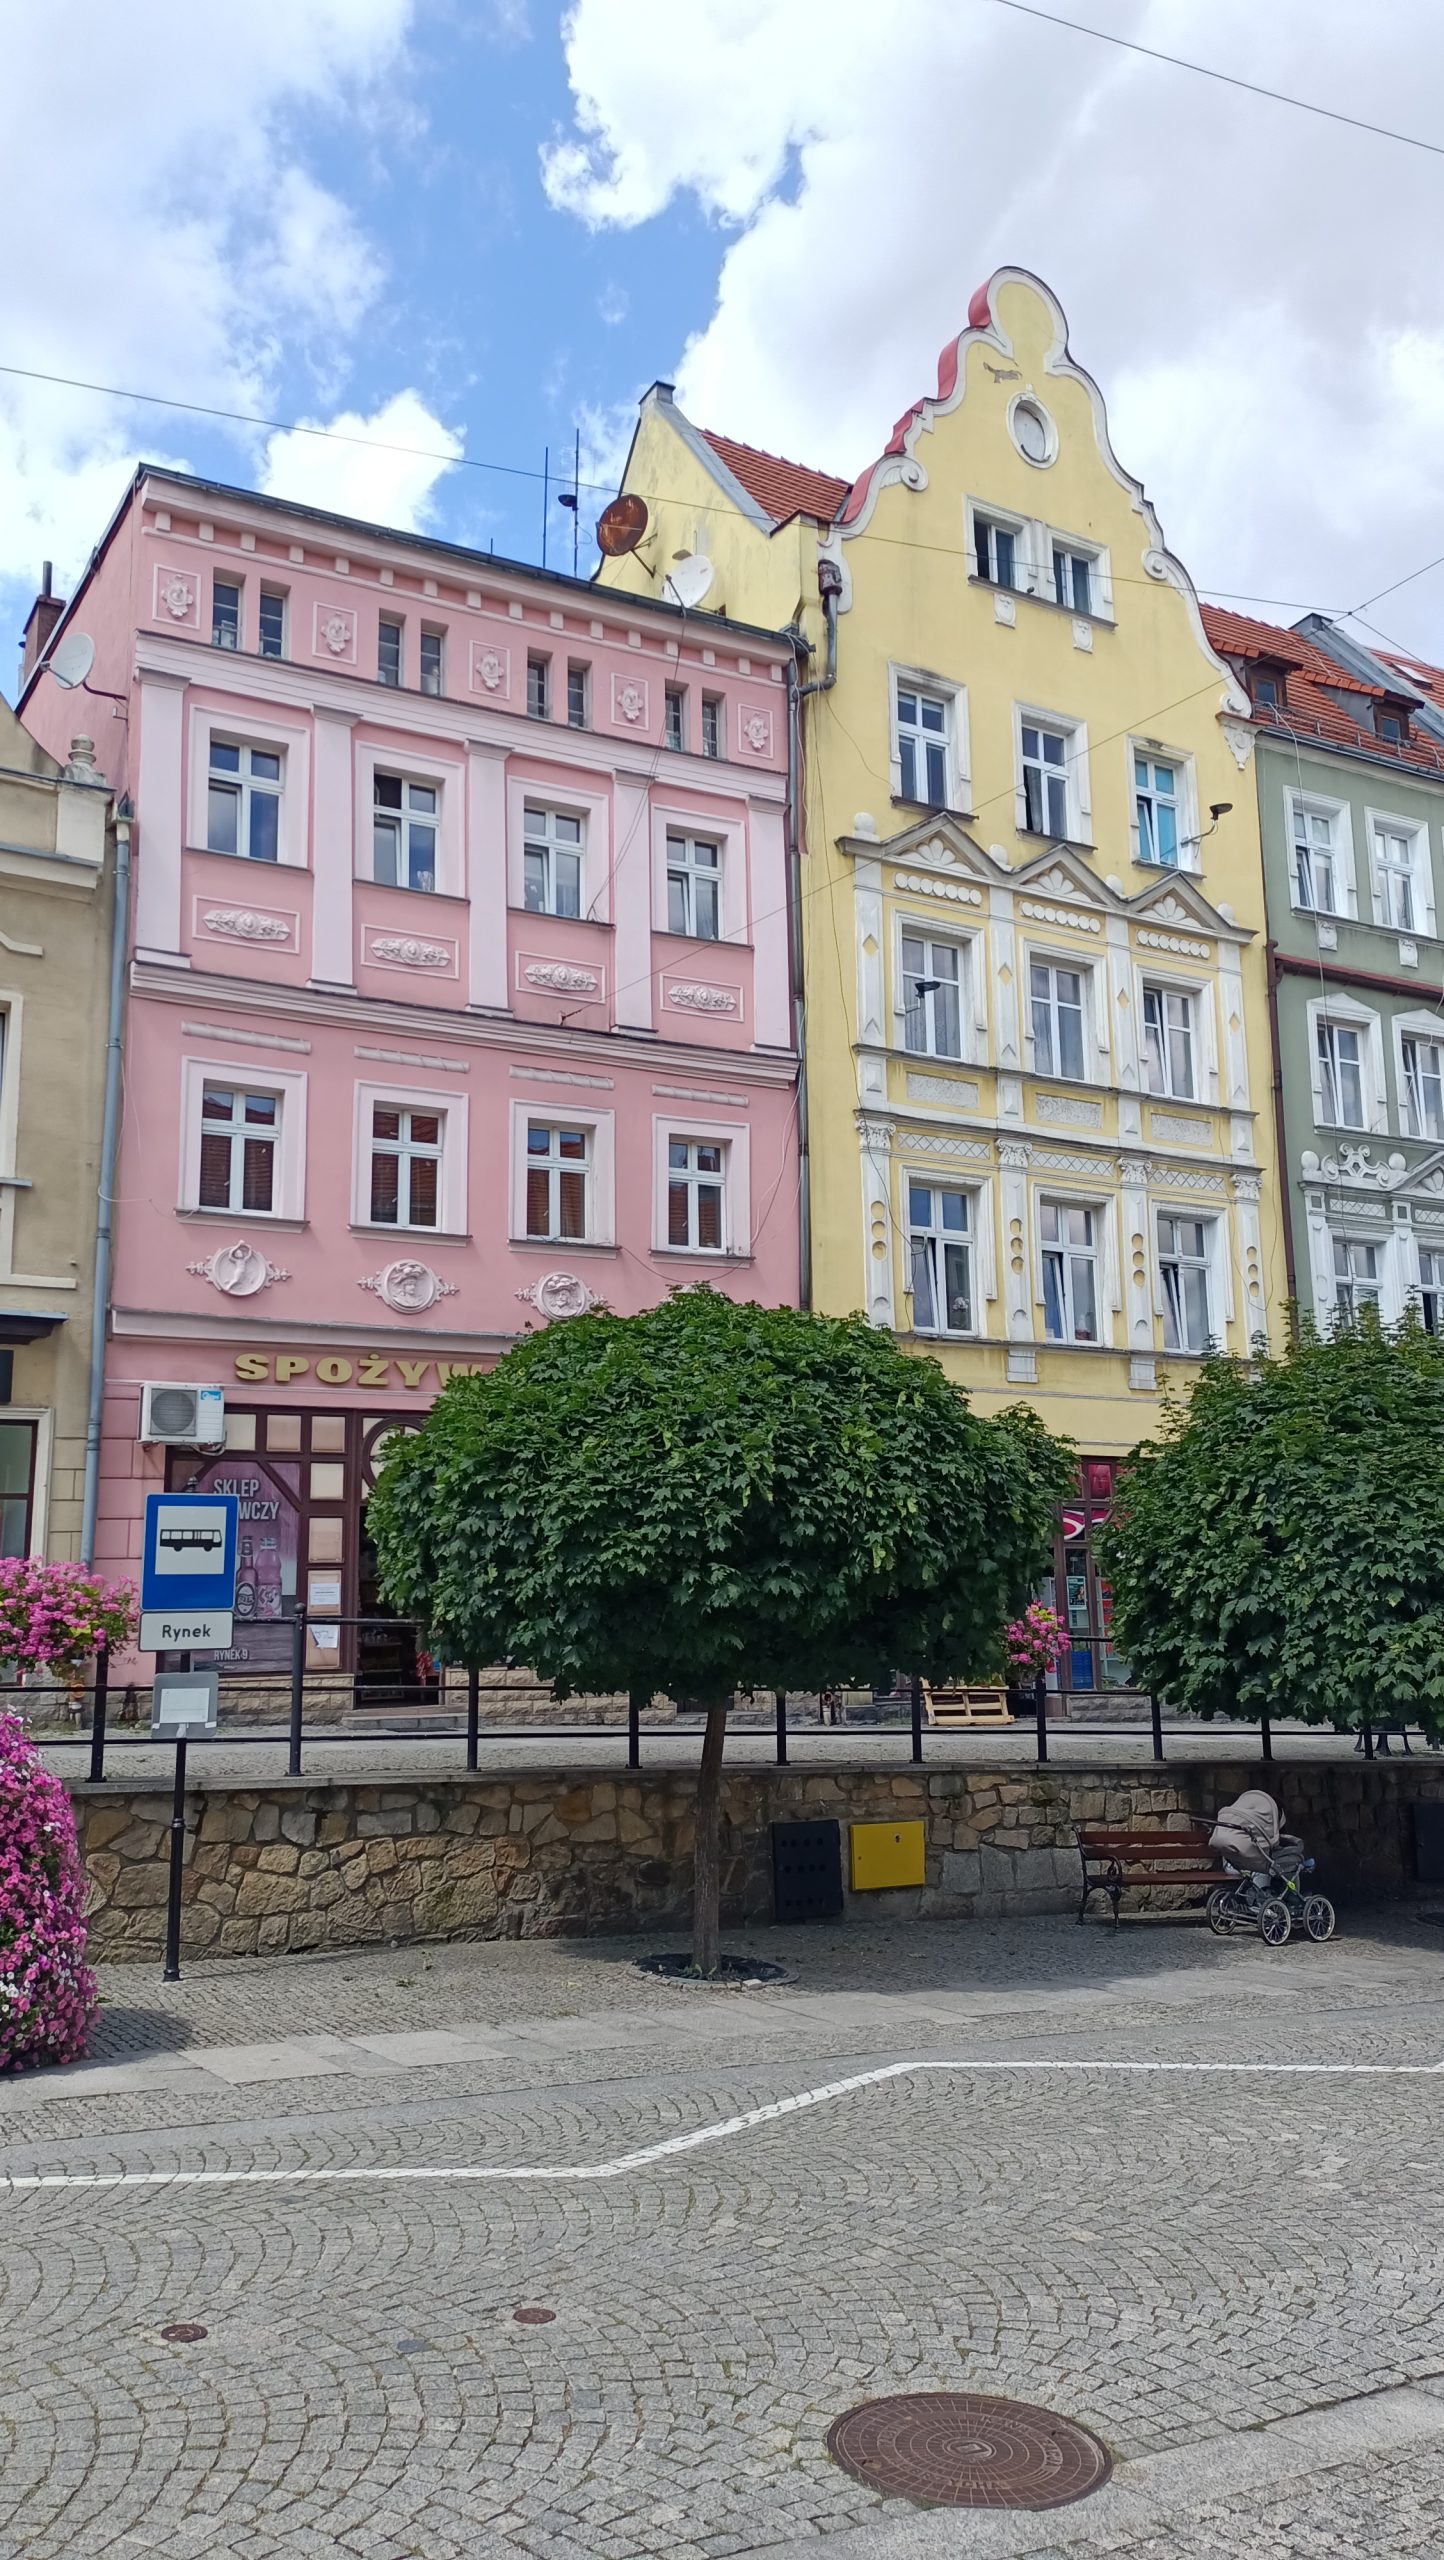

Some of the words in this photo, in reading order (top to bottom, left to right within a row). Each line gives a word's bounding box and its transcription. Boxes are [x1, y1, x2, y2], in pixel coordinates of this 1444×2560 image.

[234, 1353, 494, 1388] SPOŻYW
[213, 1479, 260, 1497] SKLEP
[162, 1624, 211, 1642] Rynek
[214, 1649, 240, 1661] RYNEK
